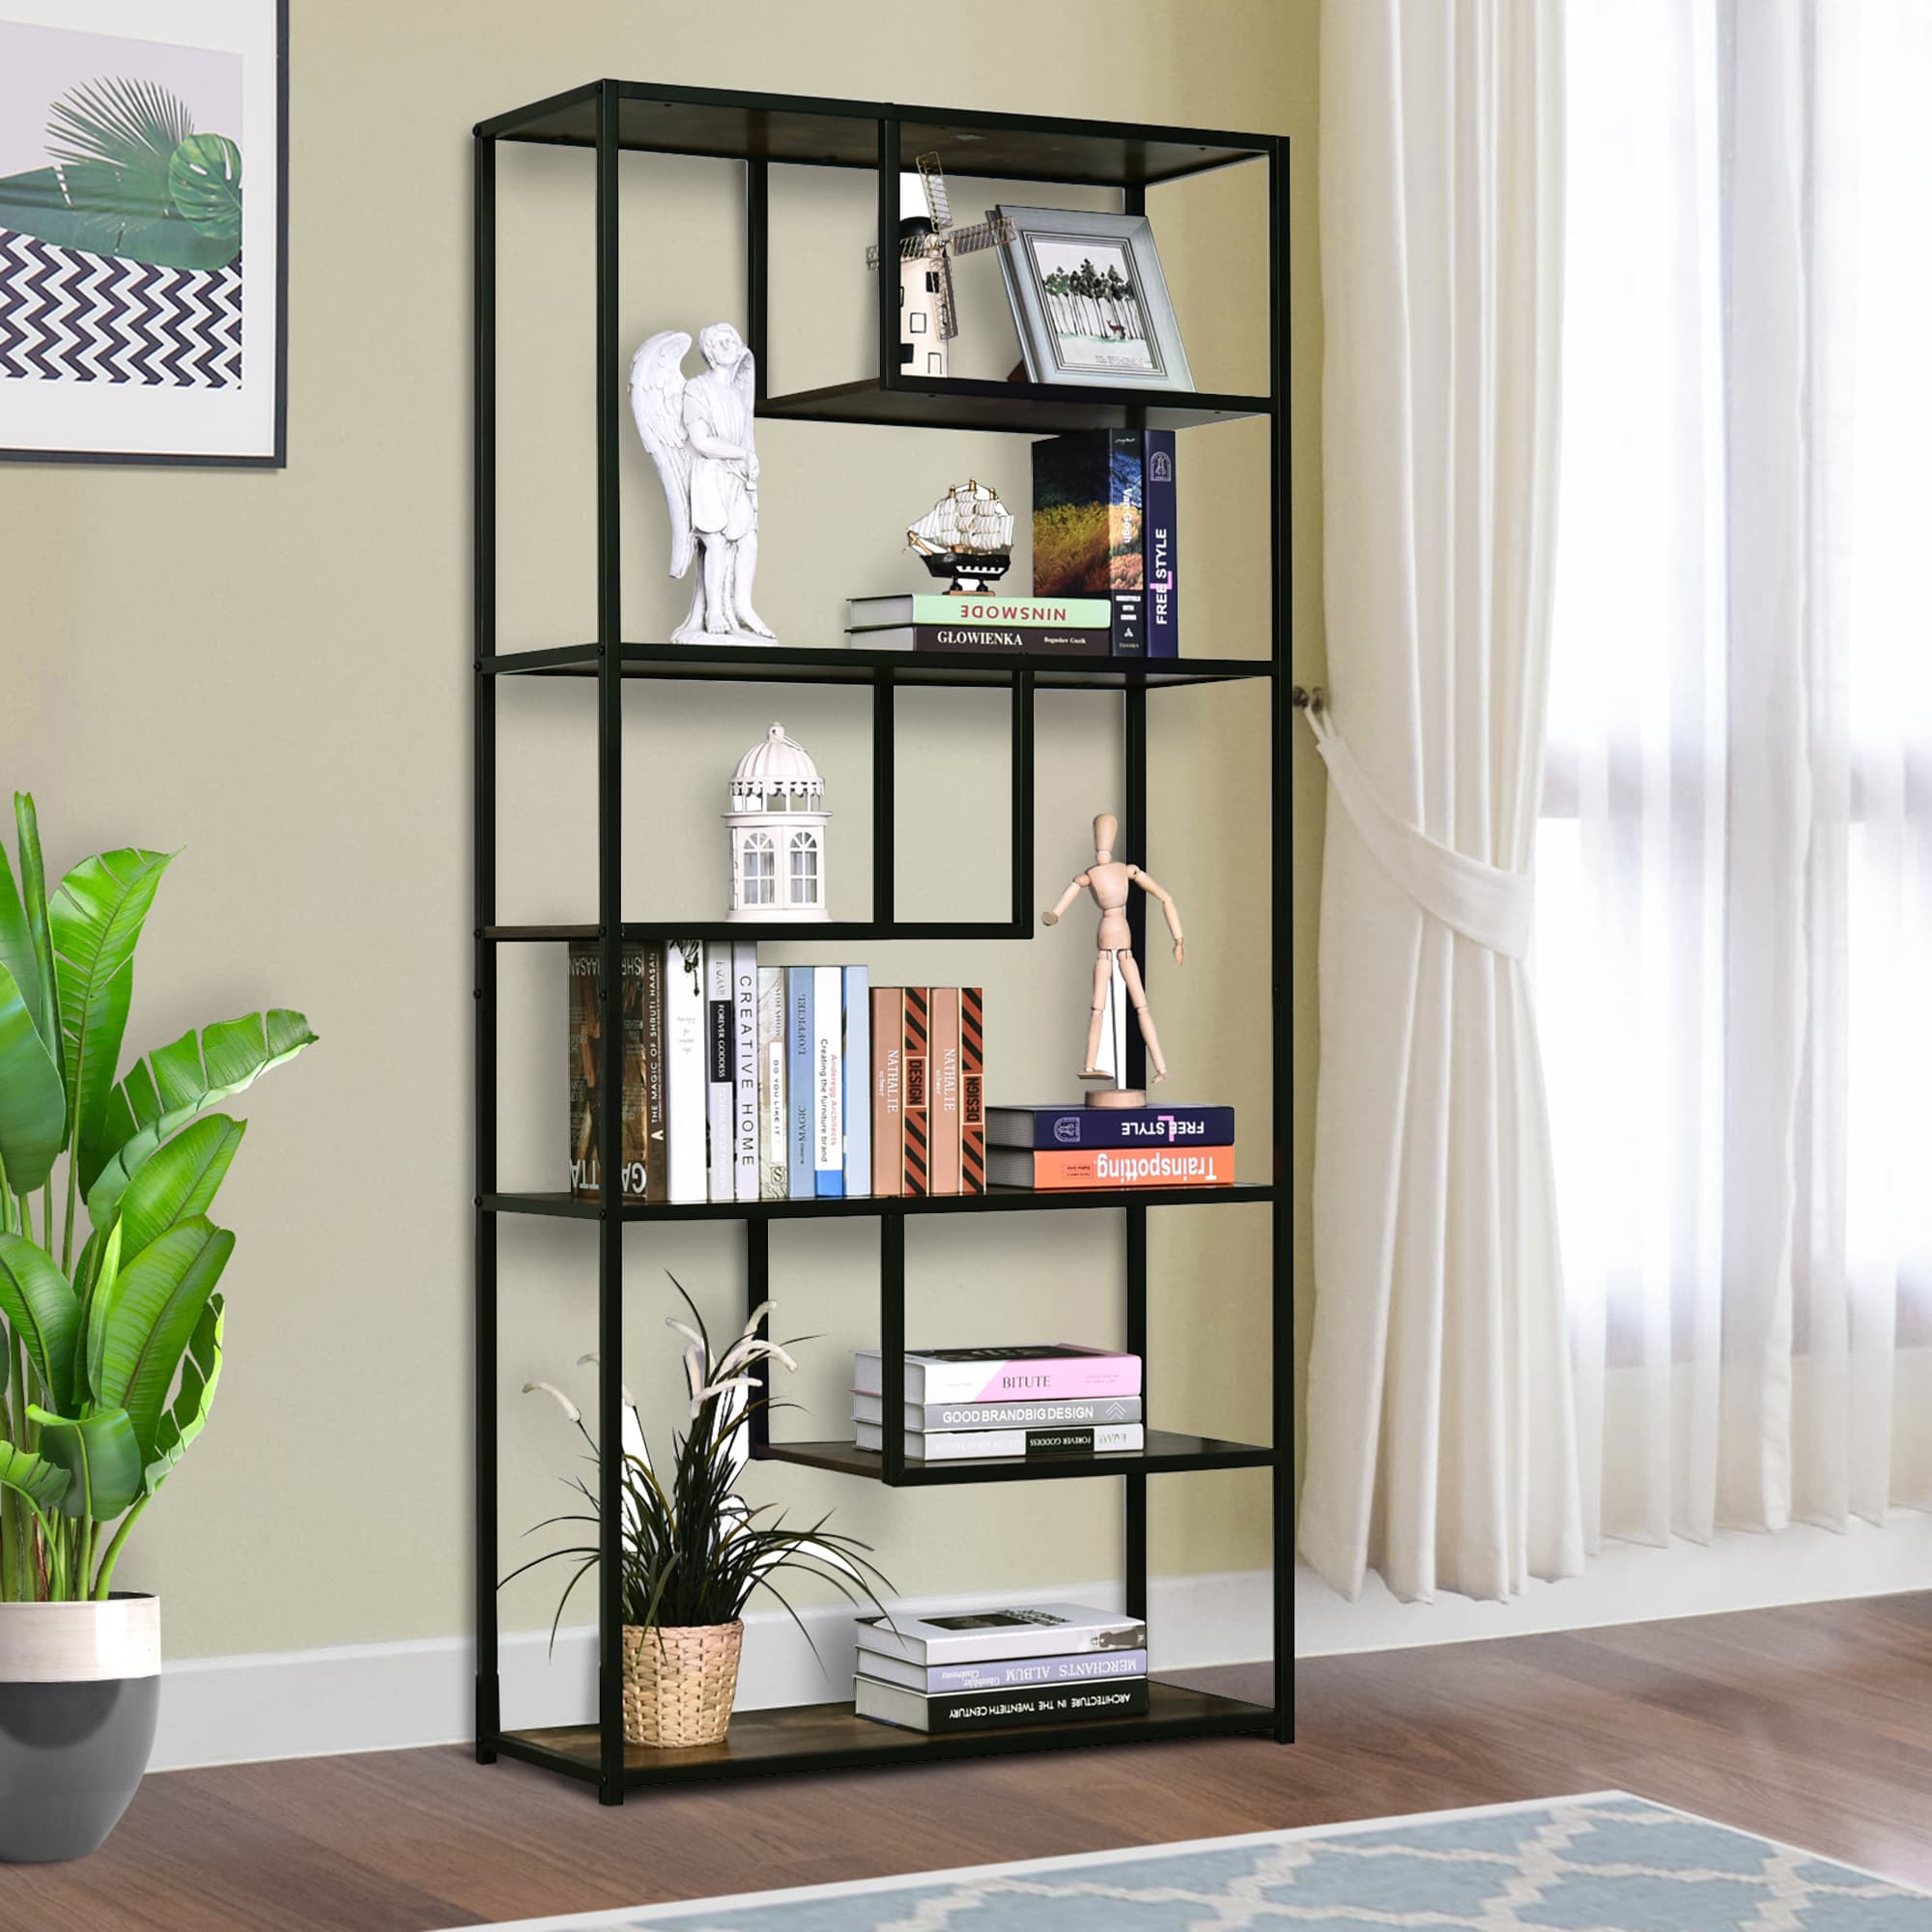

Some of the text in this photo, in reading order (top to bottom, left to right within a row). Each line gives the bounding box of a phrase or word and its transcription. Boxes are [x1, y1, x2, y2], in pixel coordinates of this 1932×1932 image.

[1122, 487, 1134, 543] Van Gogh
[1156, 527, 1167, 579] STYLE
[960, 605, 1066, 621] NINSMODE
[1156, 582, 1168, 624] FREE
[648, 952, 657, 996] HAASAN
[649, 1042, 657, 1057] OF
[717, 1004, 727, 1078] FOREVER GODDESS
[740, 975, 754, 1166] CREATIVE HOME
[887, 1049, 898, 1114] NATHALIE
[909, 1059, 922, 1105] DESIGN
[944, 1048, 955, 1112] NATHALIE
[819, 1038, 830, 1162] Creating the furniture brand
[829, 1054, 838, 1146] Anderegg Architects
[967, 1076, 980, 1122] DESIGN
[773, 1125, 781, 1135] IT
[797, 1105, 807, 1142] MAGIC
[1122, 1122, 1165, 1136] STYLE
[1167, 1121, 1205, 1134] FREE
[1002, 1376, 1051, 1389] BITUTE
[1030, 1436, 1062, 1447] GODDESS
[1063, 1435, 1091, 1446] FOREVER
[1006, 1659, 1137, 1681] MERCHANTS ALBUM
[949, 1693, 1131, 1719] ARCHITECTURE IN THE TWENTIETH CENTURY
